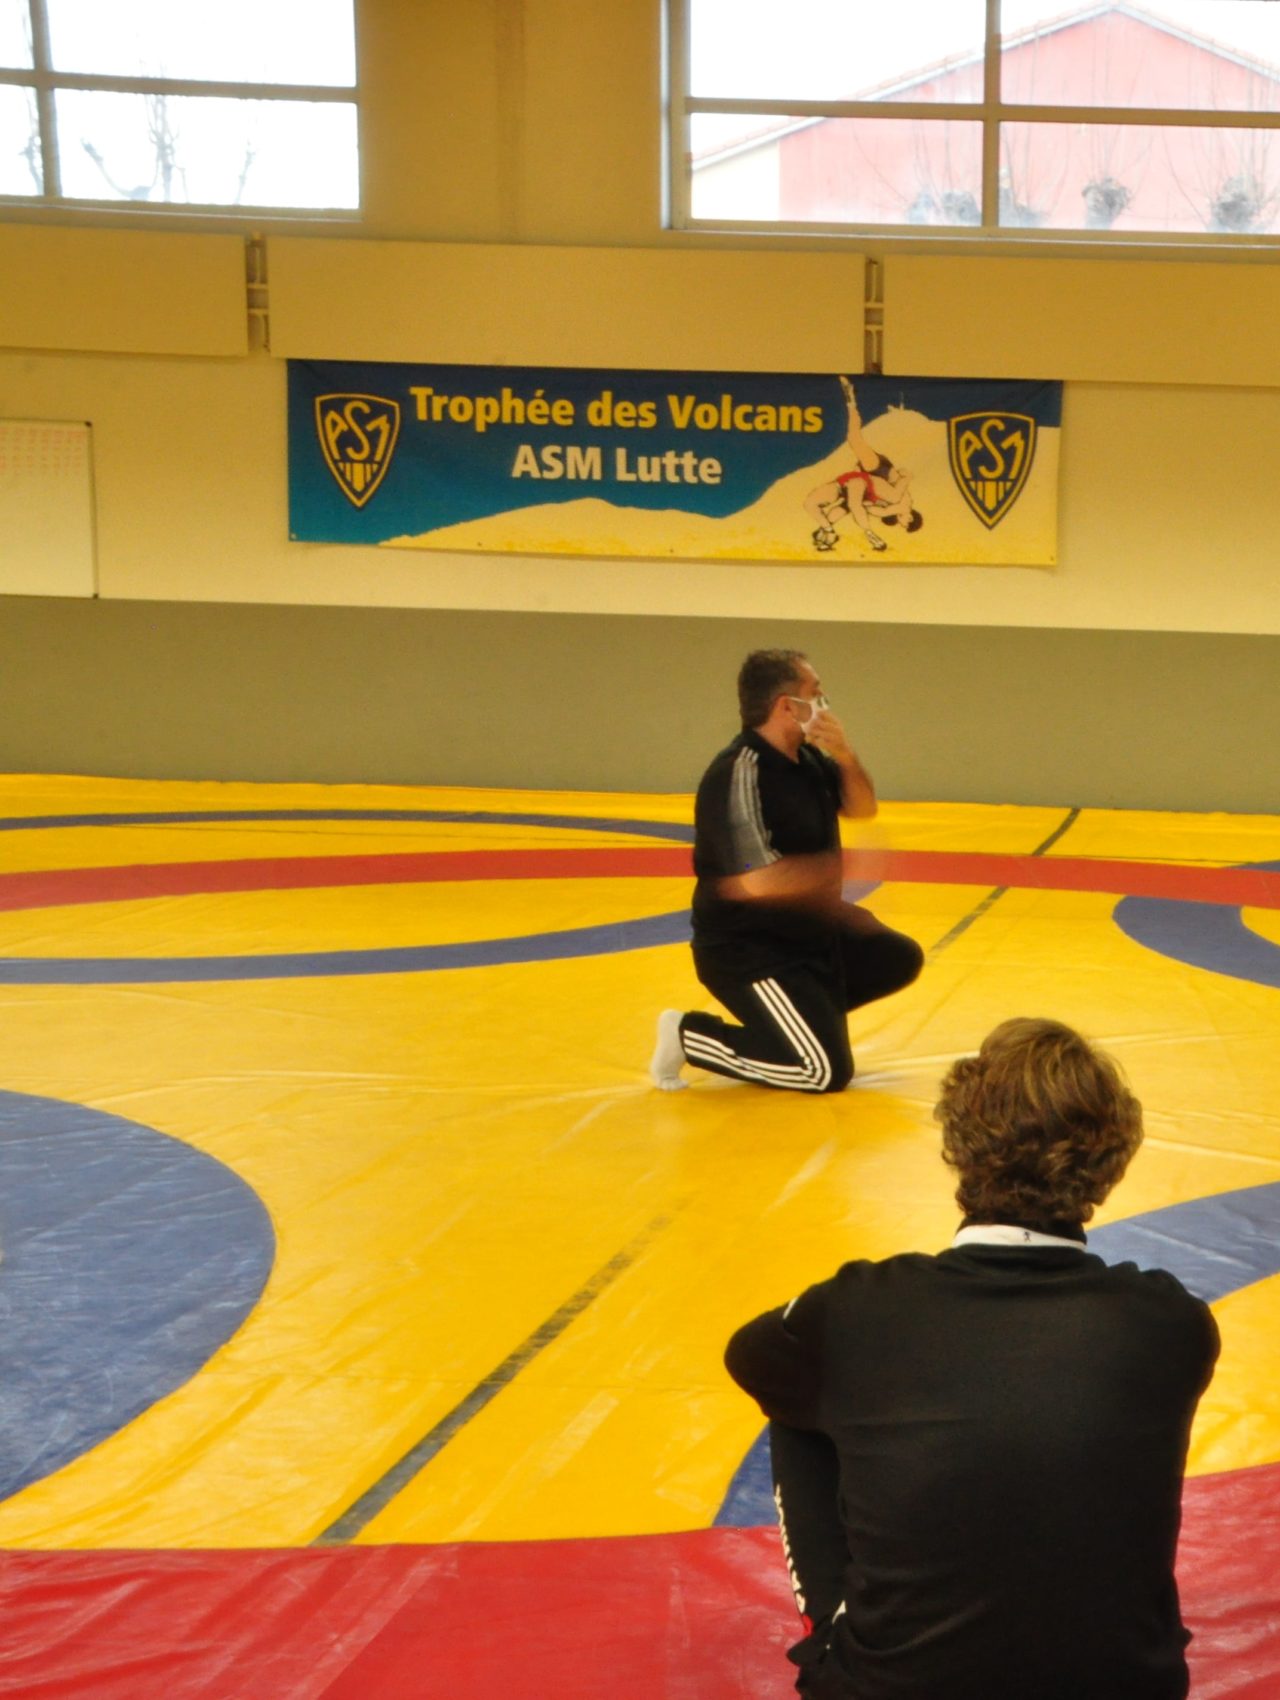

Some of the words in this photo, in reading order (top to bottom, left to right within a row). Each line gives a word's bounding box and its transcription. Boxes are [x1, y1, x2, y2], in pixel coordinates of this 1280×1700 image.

[324, 401, 390, 461] ASM
[409, 387, 574, 432] Trophée
[588, 391, 657, 428] des
[667, 394, 823, 433] Volcans
[511, 444, 601, 481] ASM
[616, 448, 722, 483] Lutte
[959, 418, 1025, 479] ASM
